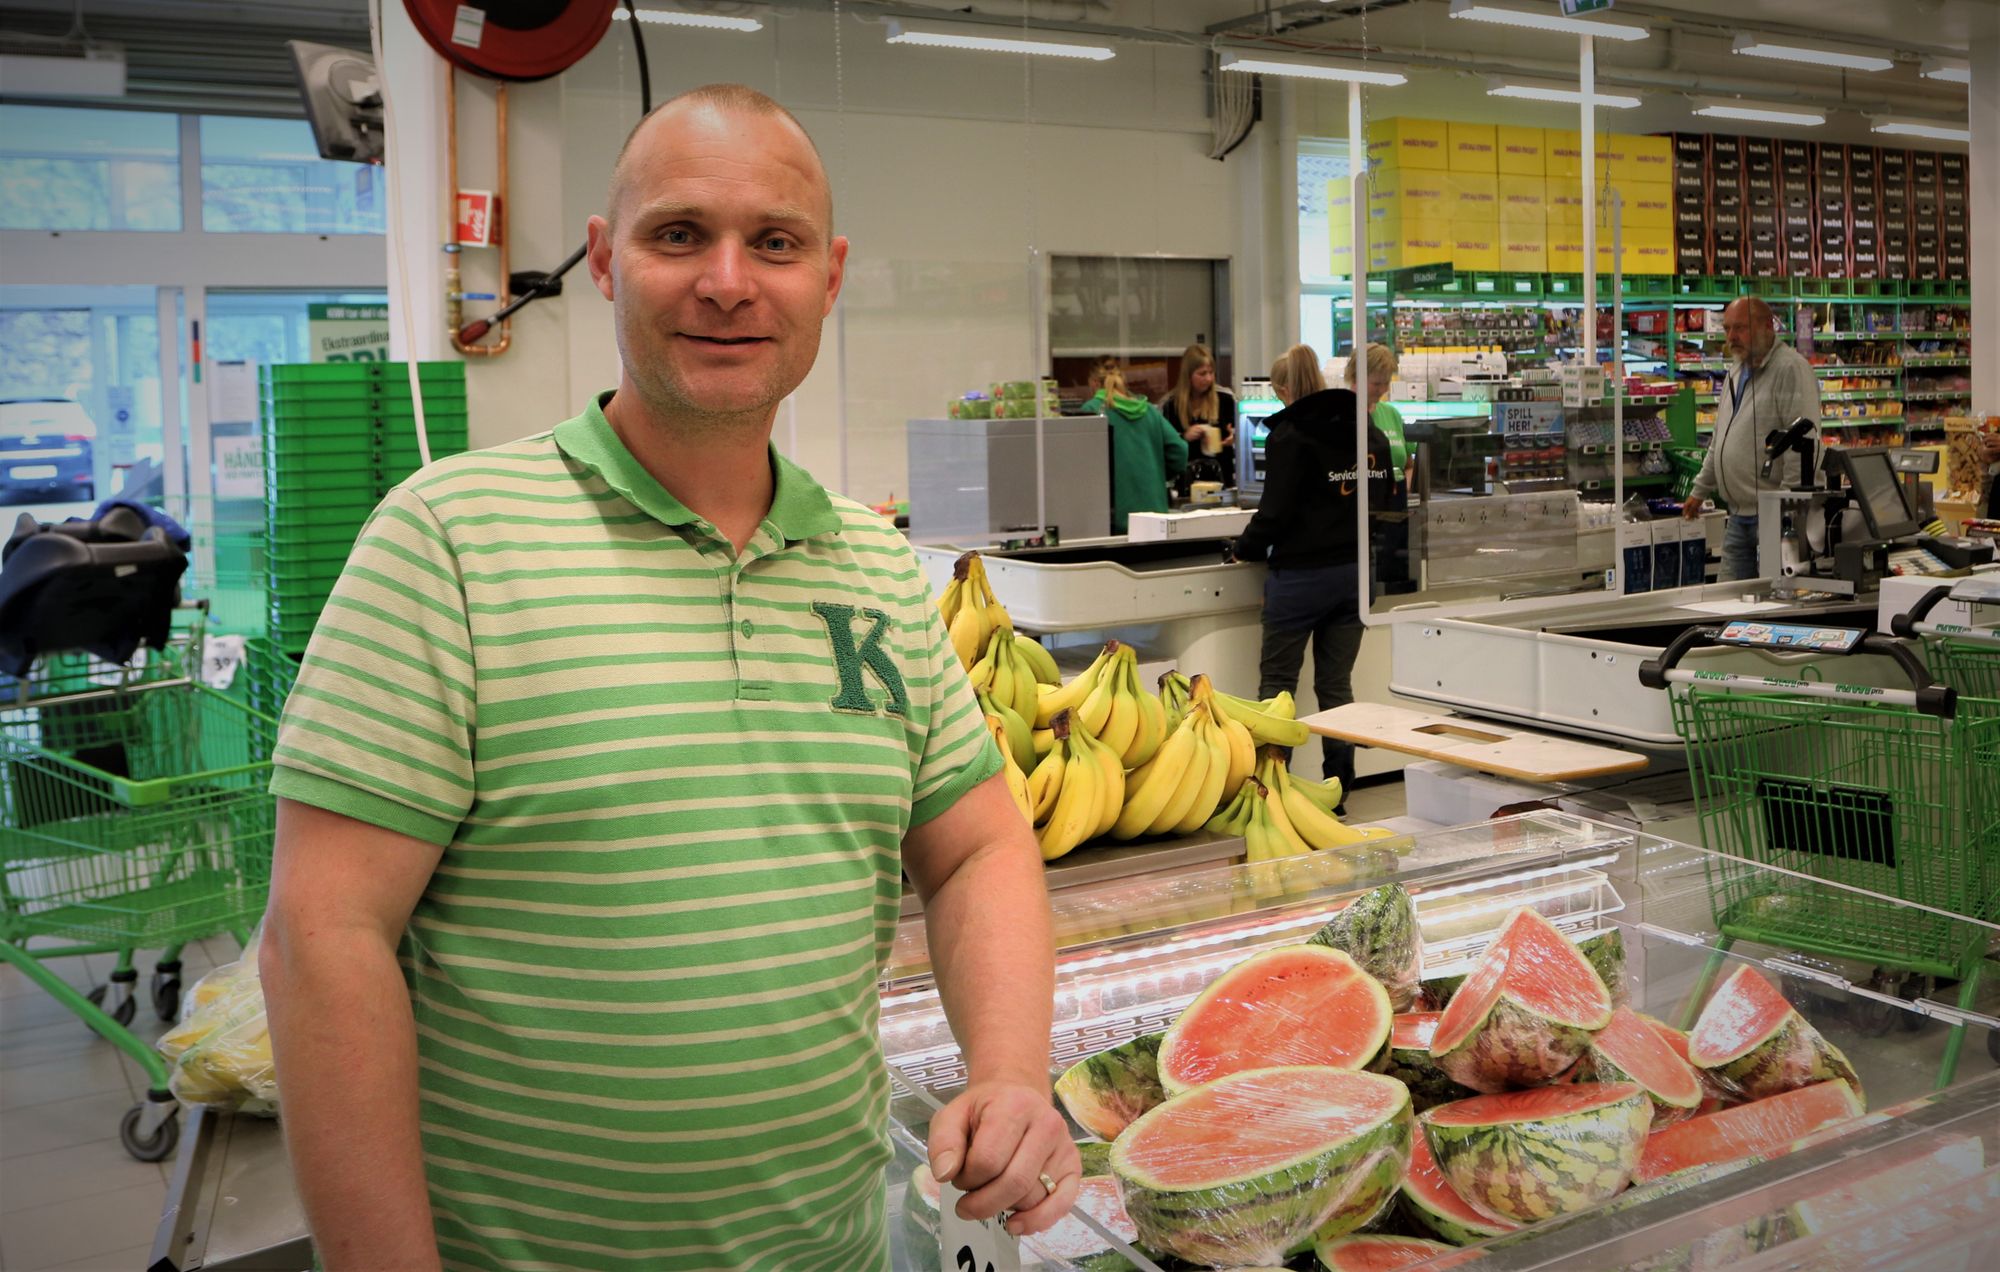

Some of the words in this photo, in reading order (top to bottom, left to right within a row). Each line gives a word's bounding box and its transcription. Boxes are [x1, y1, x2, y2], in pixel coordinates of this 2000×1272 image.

[1679, 142, 1700, 150] twist
[1716, 142, 1735, 151] twist
[1749, 145, 1768, 153] twist
[1822, 151, 1840, 159] twist
[1680, 177, 1700, 185] twist
[1717, 179, 1736, 187] twist
[1786, 182, 1805, 190] twist
[1823, 185, 1841, 193] twist
[1854, 186, 1871, 194] twist
[1917, 190, 1934, 198] twist
[1680, 213, 1700, 221] twist
[1753, 215, 1772, 223] twist
[1788, 216, 1807, 224] twist
[1824, 219, 1842, 227] twist
[1855, 219, 1873, 228] twist
[1681, 248, 1701, 256] twist
[1718, 249, 1737, 257] twist
[1755, 250, 1773, 258] twist
[1790, 251, 1808, 259] twist
[1824, 252, 1842, 261] twist
[1856, 253, 1874, 261] twist
[1919, 255, 1935, 263] twist
[1508, 408, 1533, 419] SPILL
[1508, 421, 1530, 431] HER!
[1328, 469, 1387, 482] Servicetner1
[811, 601, 907, 716] K
